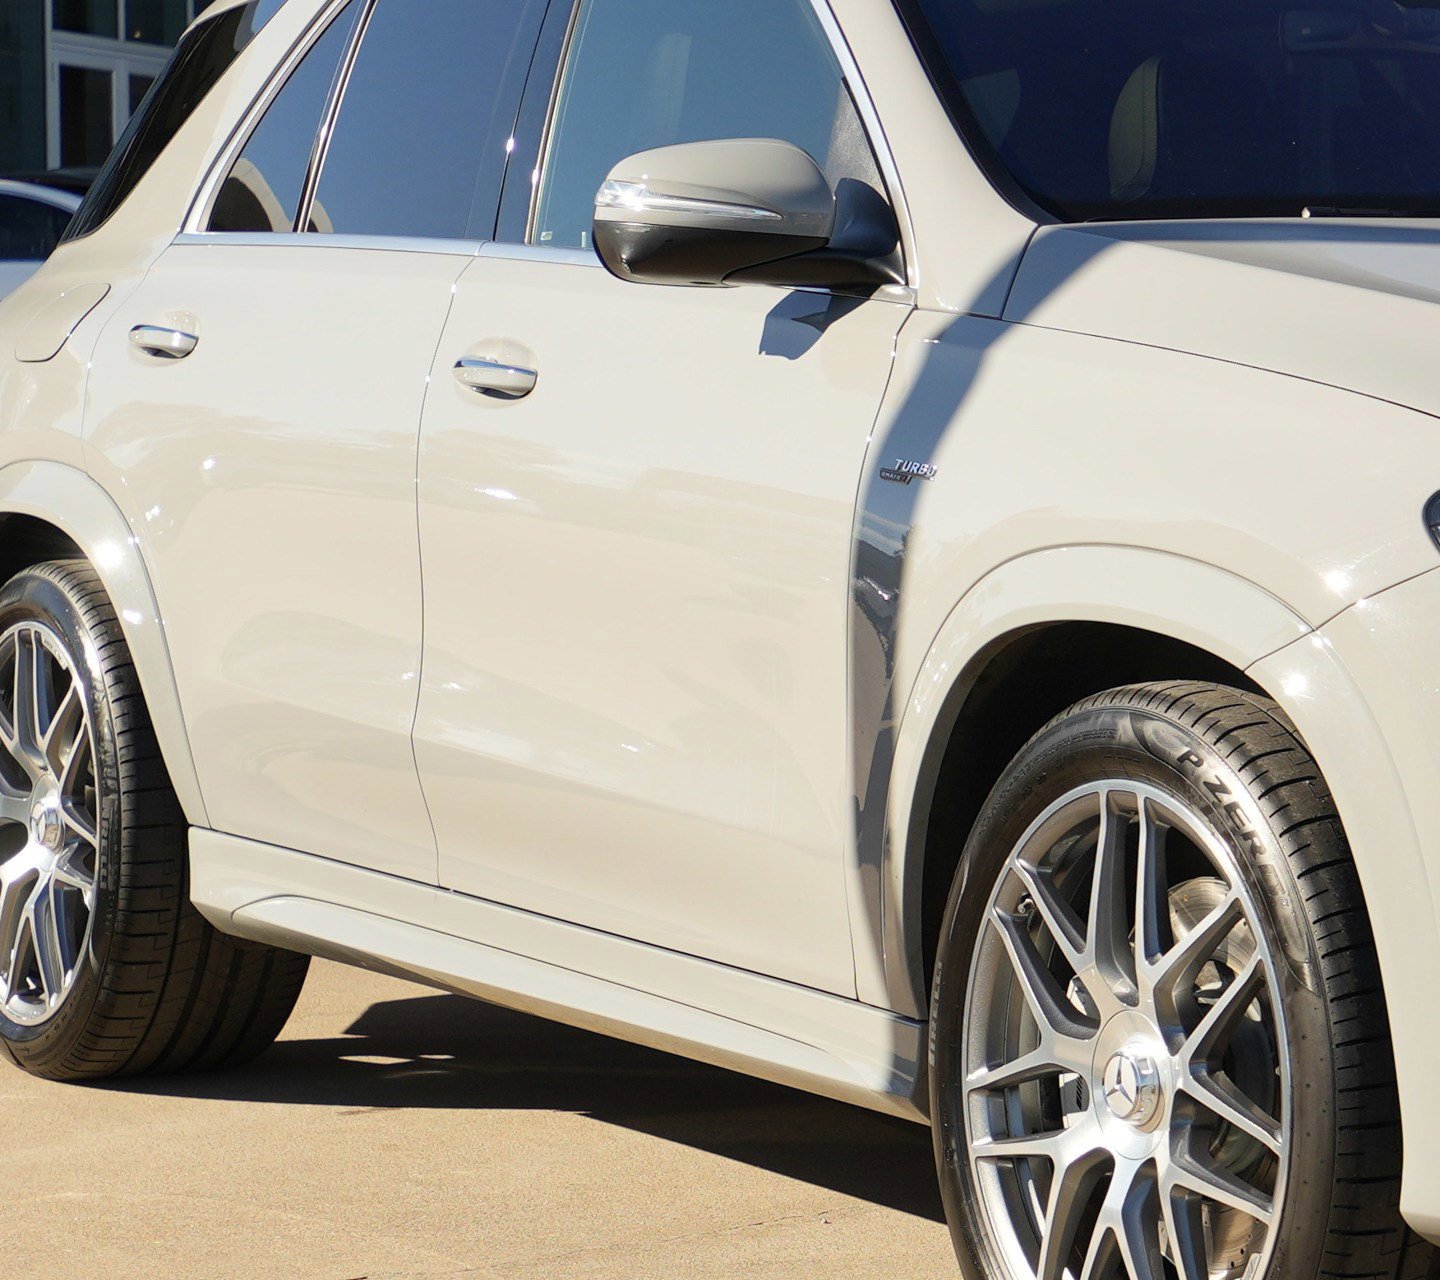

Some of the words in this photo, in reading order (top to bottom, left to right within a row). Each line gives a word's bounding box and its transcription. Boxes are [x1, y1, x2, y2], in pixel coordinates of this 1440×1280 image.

[894, 458, 938, 478] TURBO
[1176, 749, 1205, 768] P
[1203, 774, 1287, 896] ZERO
